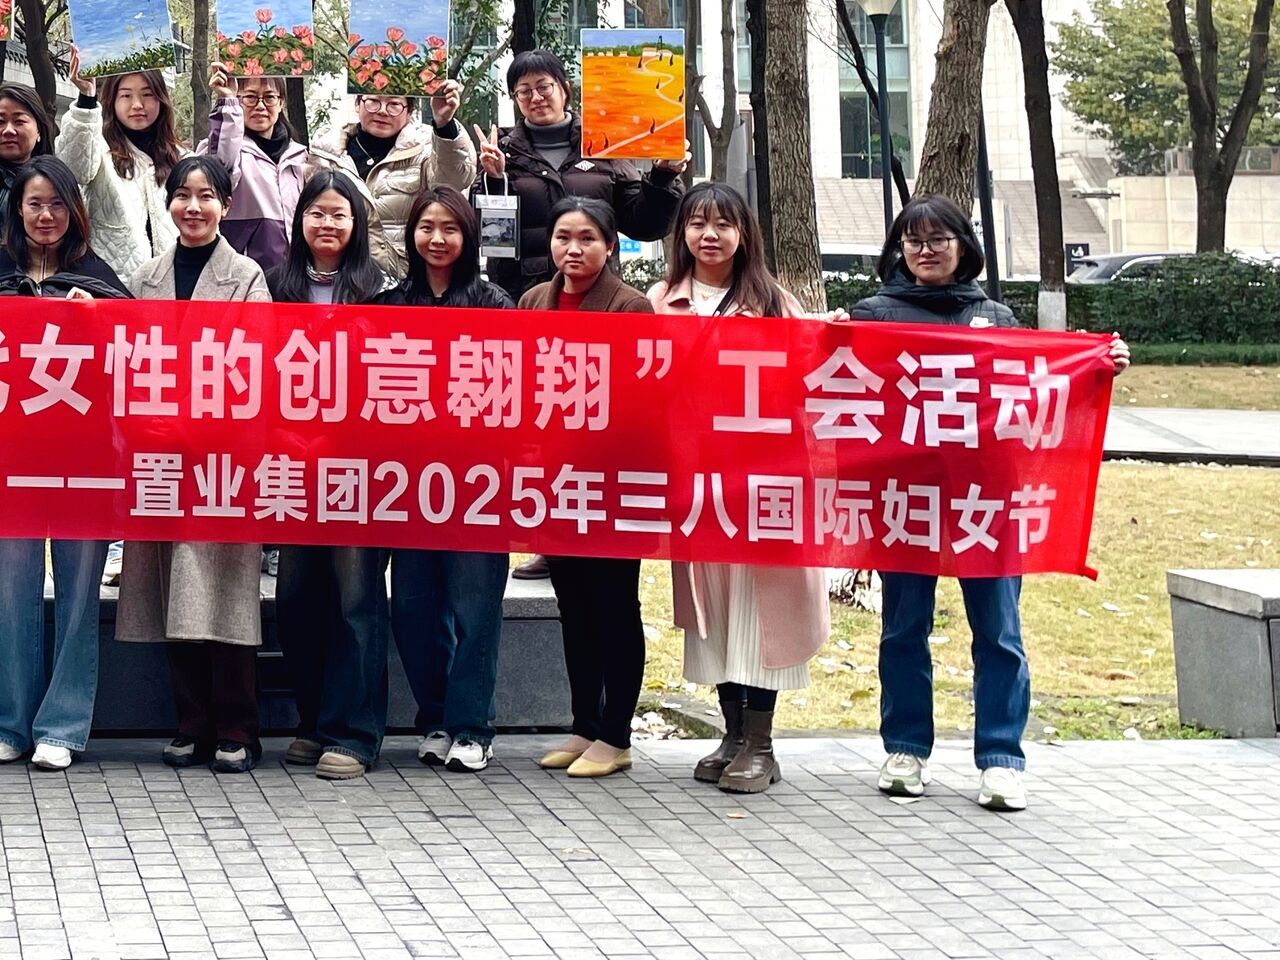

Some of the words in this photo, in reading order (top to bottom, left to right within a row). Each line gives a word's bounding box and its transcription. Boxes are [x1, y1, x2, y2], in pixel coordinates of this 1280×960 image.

[6, 451, 1057, 555] ——置业集团2025年三八国际妇女节
